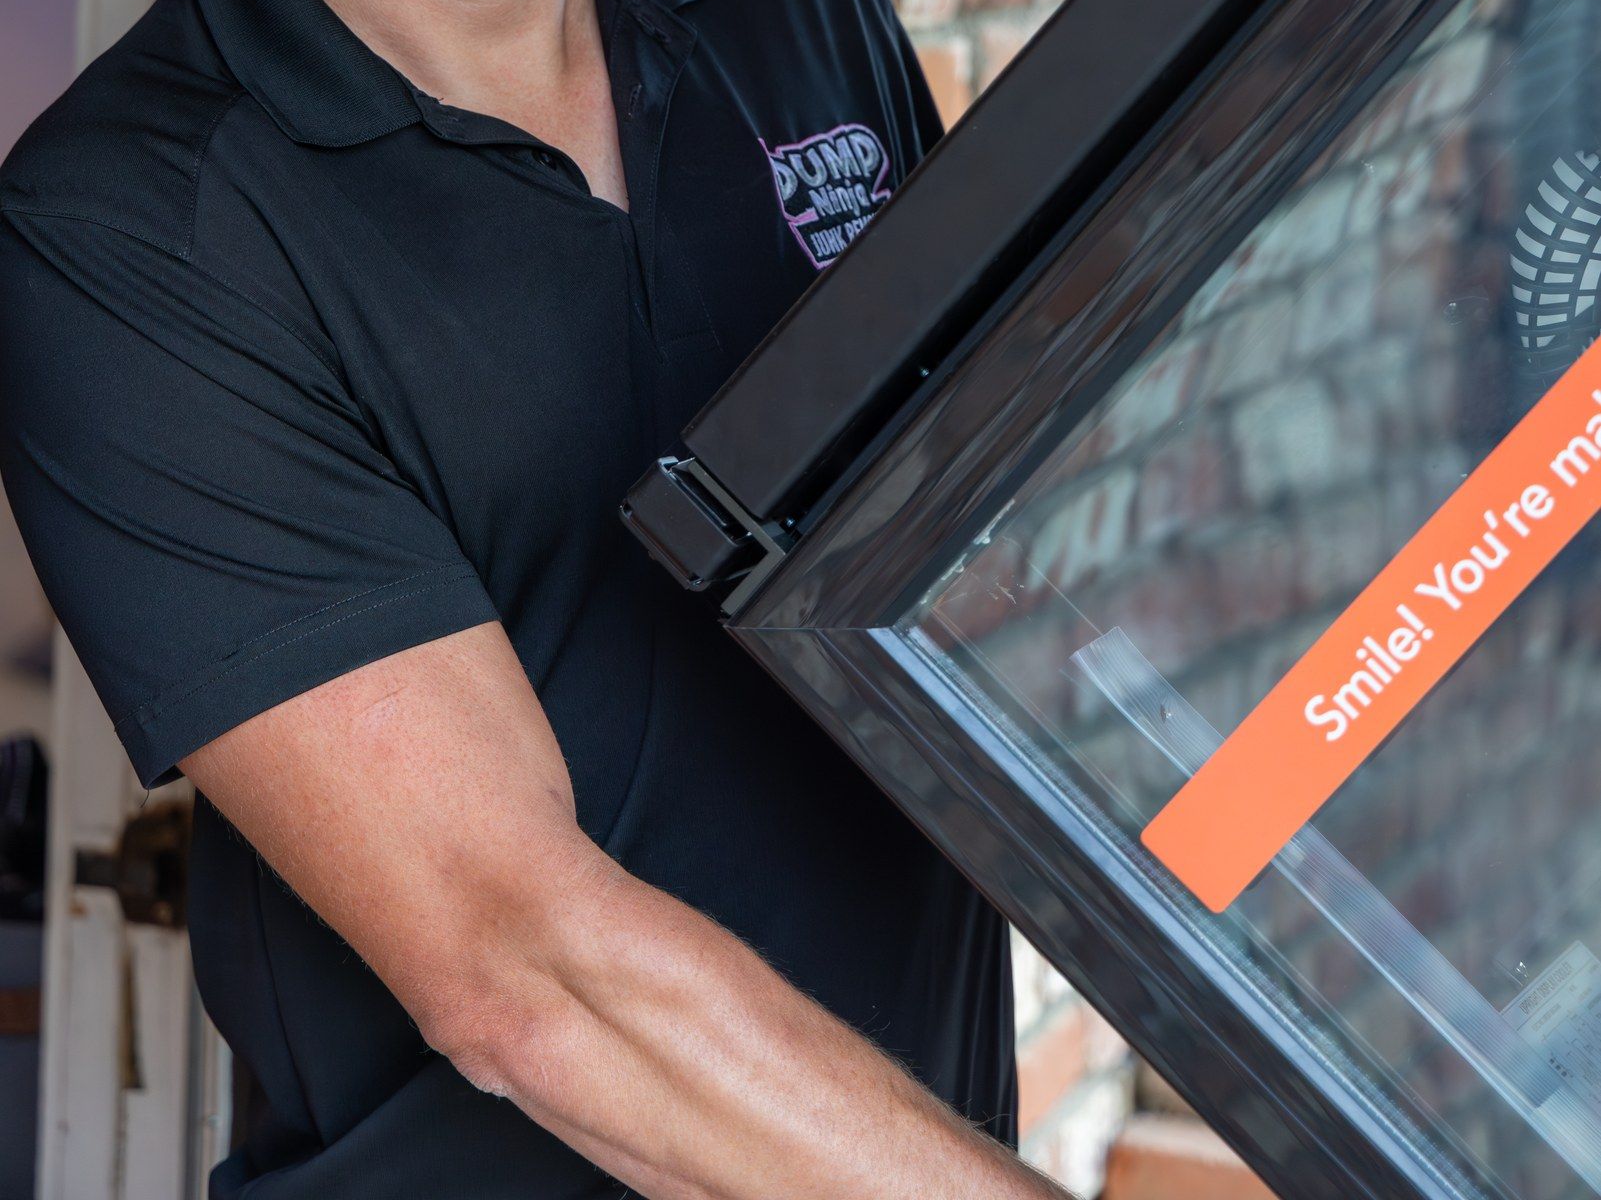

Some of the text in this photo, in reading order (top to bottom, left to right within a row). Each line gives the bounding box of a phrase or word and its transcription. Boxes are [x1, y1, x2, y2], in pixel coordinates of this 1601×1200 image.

[773, 131, 881, 201] DUMP
[808, 178, 871, 217] Ninja
[810, 225, 848, 257] JUNK
[1304, 388, 1601, 742] Smile! You're ma
